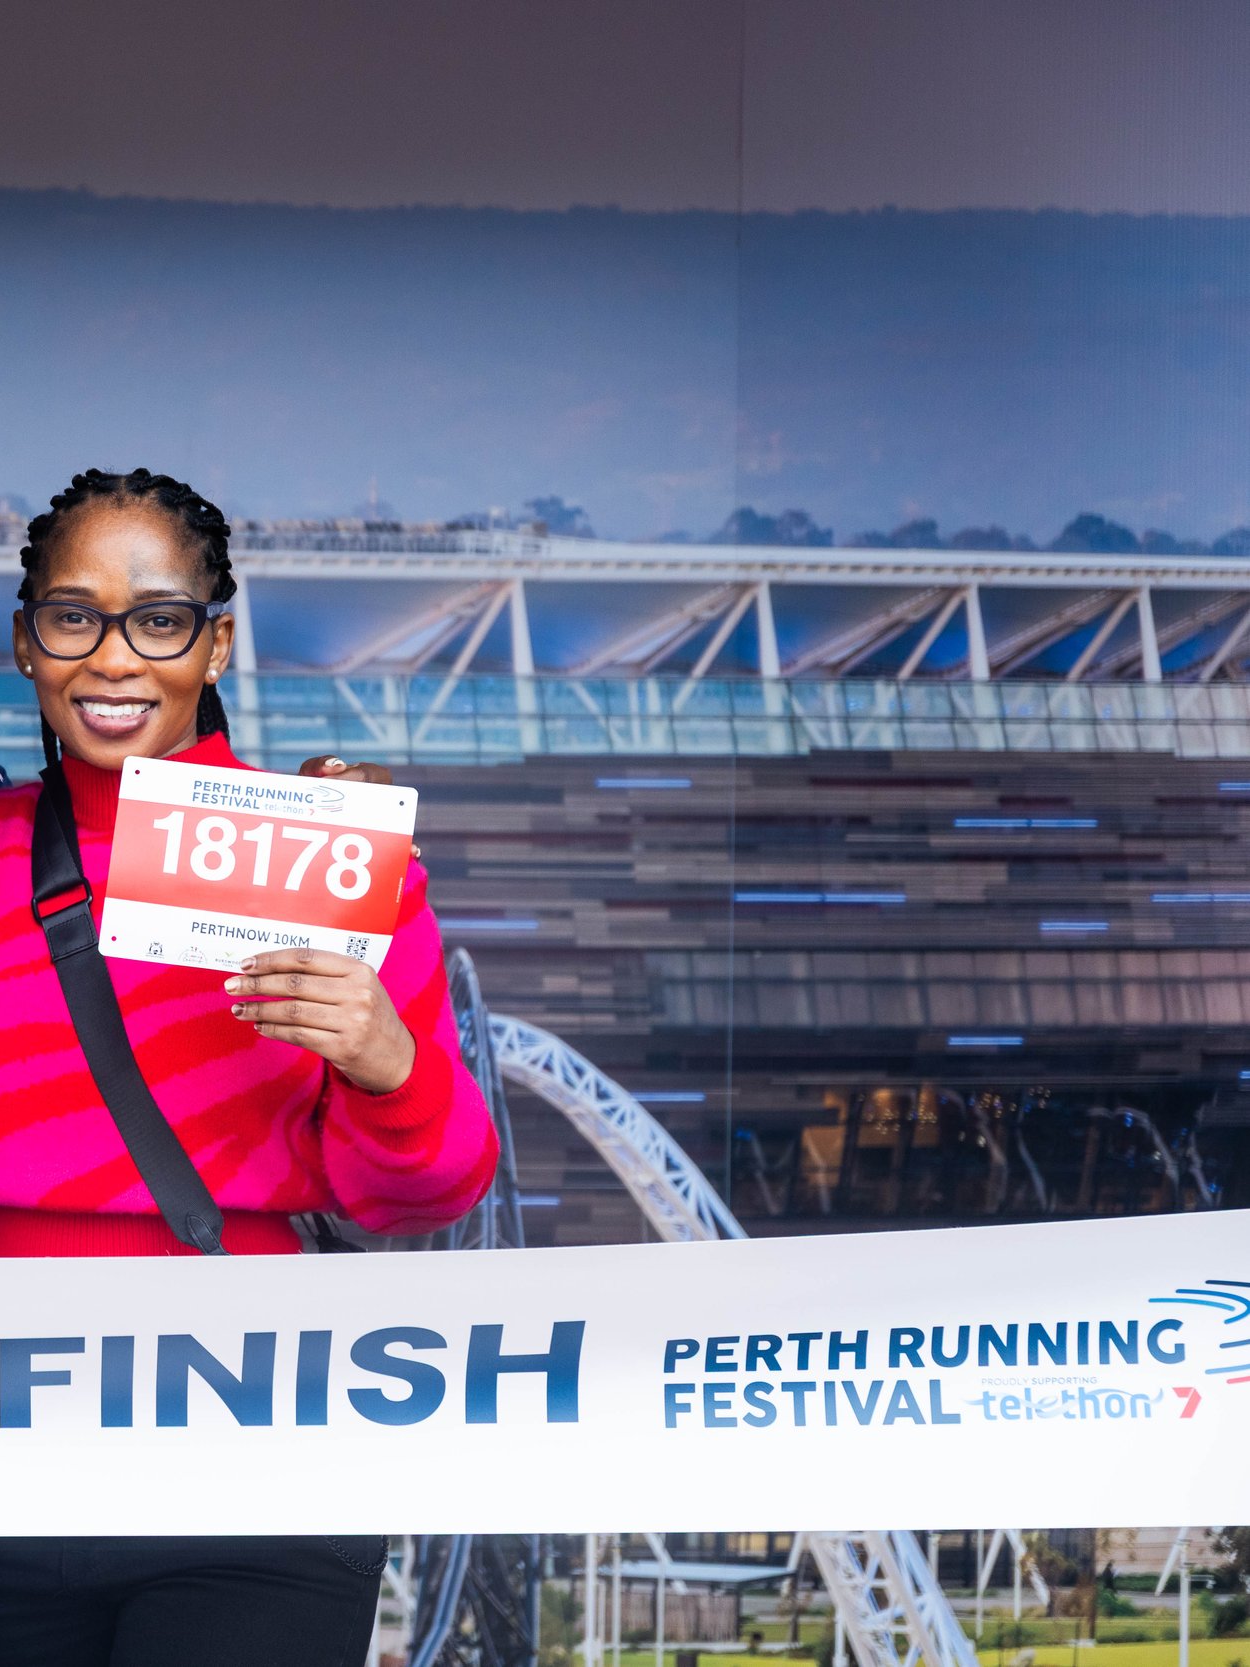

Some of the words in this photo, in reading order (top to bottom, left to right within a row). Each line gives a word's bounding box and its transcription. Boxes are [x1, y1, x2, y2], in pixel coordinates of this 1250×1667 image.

[192, 792, 260, 809] FESTIVAL
[264, 803, 304, 815] telthon
[193, 780, 242, 796] PERTH
[245, 786, 314, 804] RUNNING
[153, 810, 373, 900] 18178
[191, 921, 270, 943] PERTHNOW
[273, 932, 310, 948] 10KM
[664, 1330, 868, 1374] PERTH
[889, 1318, 1186, 1369] RUNNING
[981, 1378, 1028, 1386] PROUDLY
[1031, 1376, 1098, 1386] SUPPORTING
[664, 1378, 962, 1429] FESTIVAL
[981, 1387, 1153, 1421] telethon
[1172, 1386, 1203, 1419] 7
